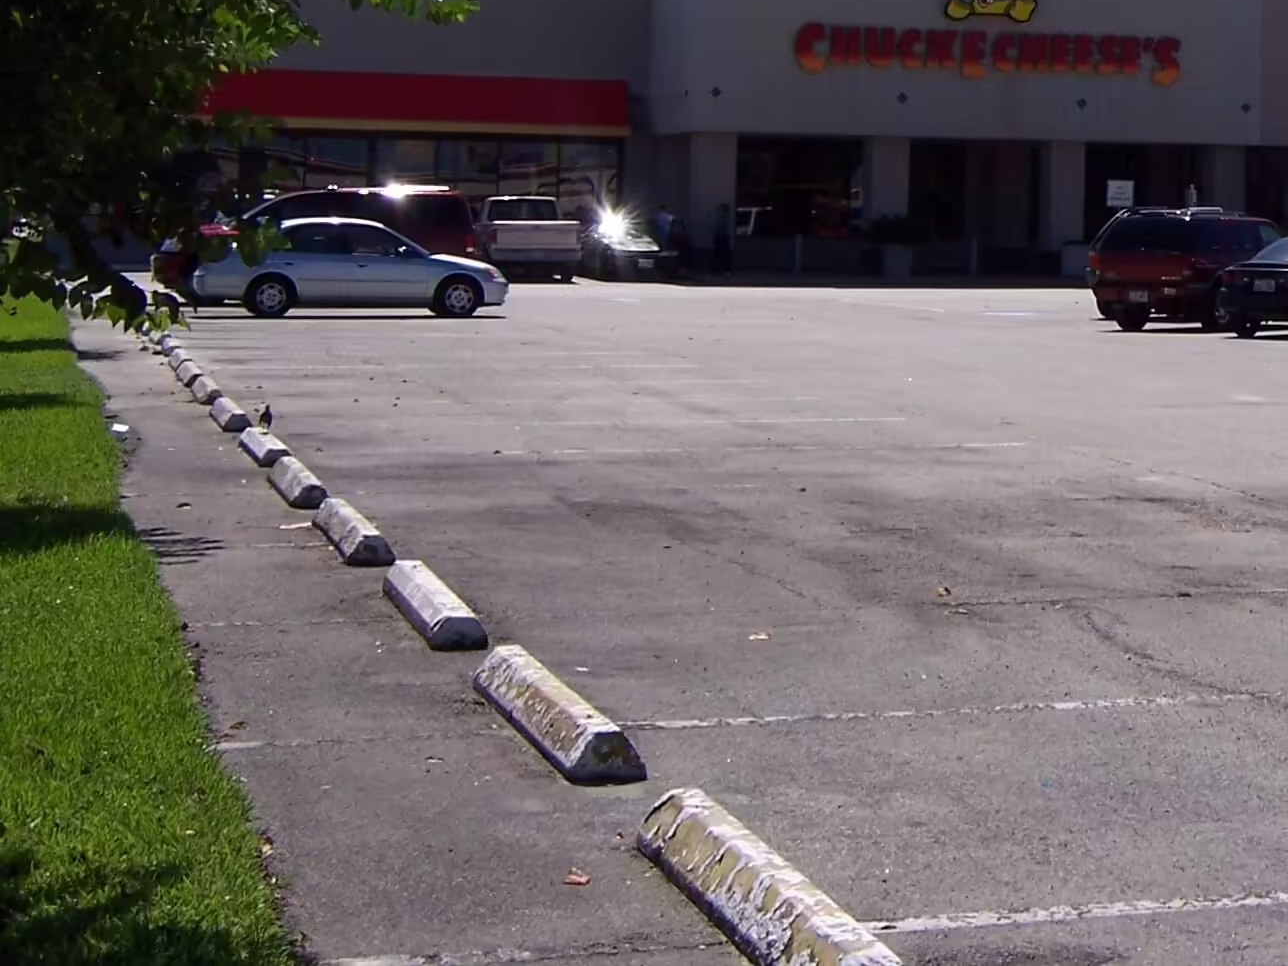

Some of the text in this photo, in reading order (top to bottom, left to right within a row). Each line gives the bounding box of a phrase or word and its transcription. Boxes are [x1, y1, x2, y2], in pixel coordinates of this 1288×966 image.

[795, 22, 1182, 87] CHUCK E CHEESE'S
